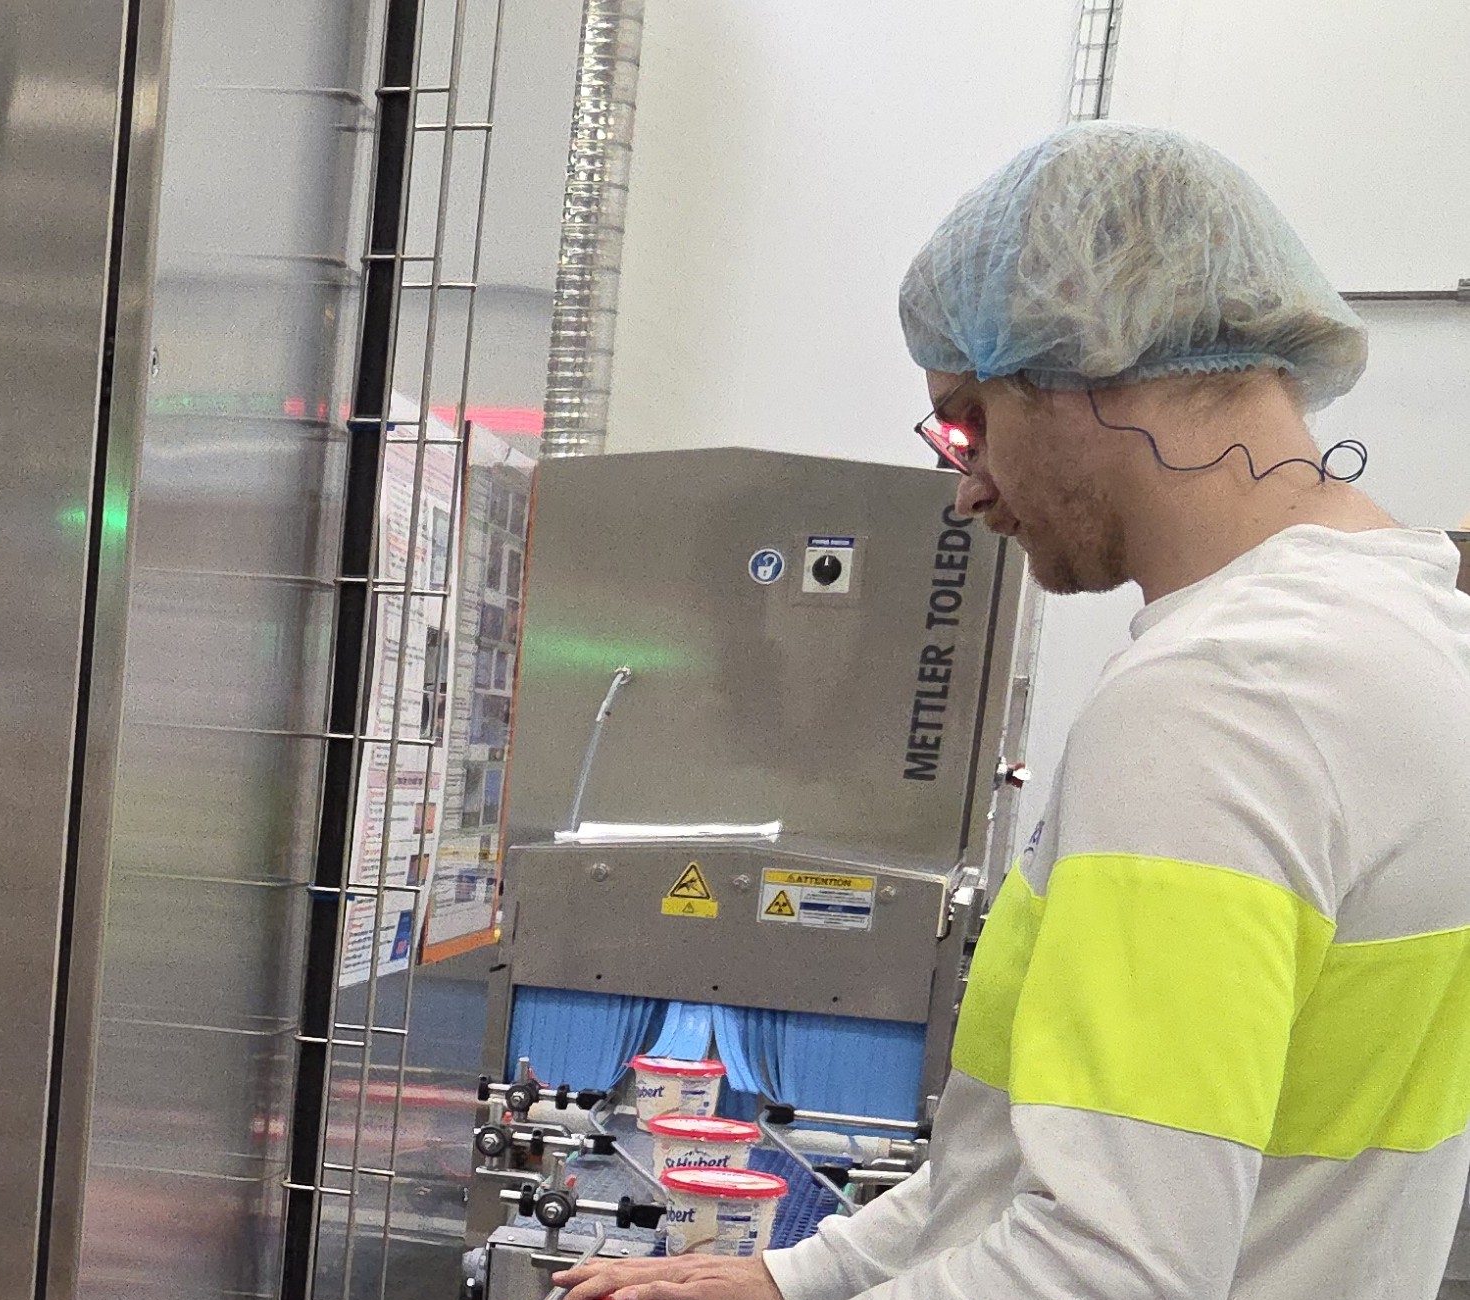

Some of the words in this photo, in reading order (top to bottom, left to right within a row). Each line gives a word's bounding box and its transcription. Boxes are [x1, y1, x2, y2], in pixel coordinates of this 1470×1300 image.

[926, 503, 974, 630] TOLEDO
[903, 643, 955, 781] METTLER
[796, 876, 852, 887] ATTENTION
[666, 1207, 696, 1222] bert
